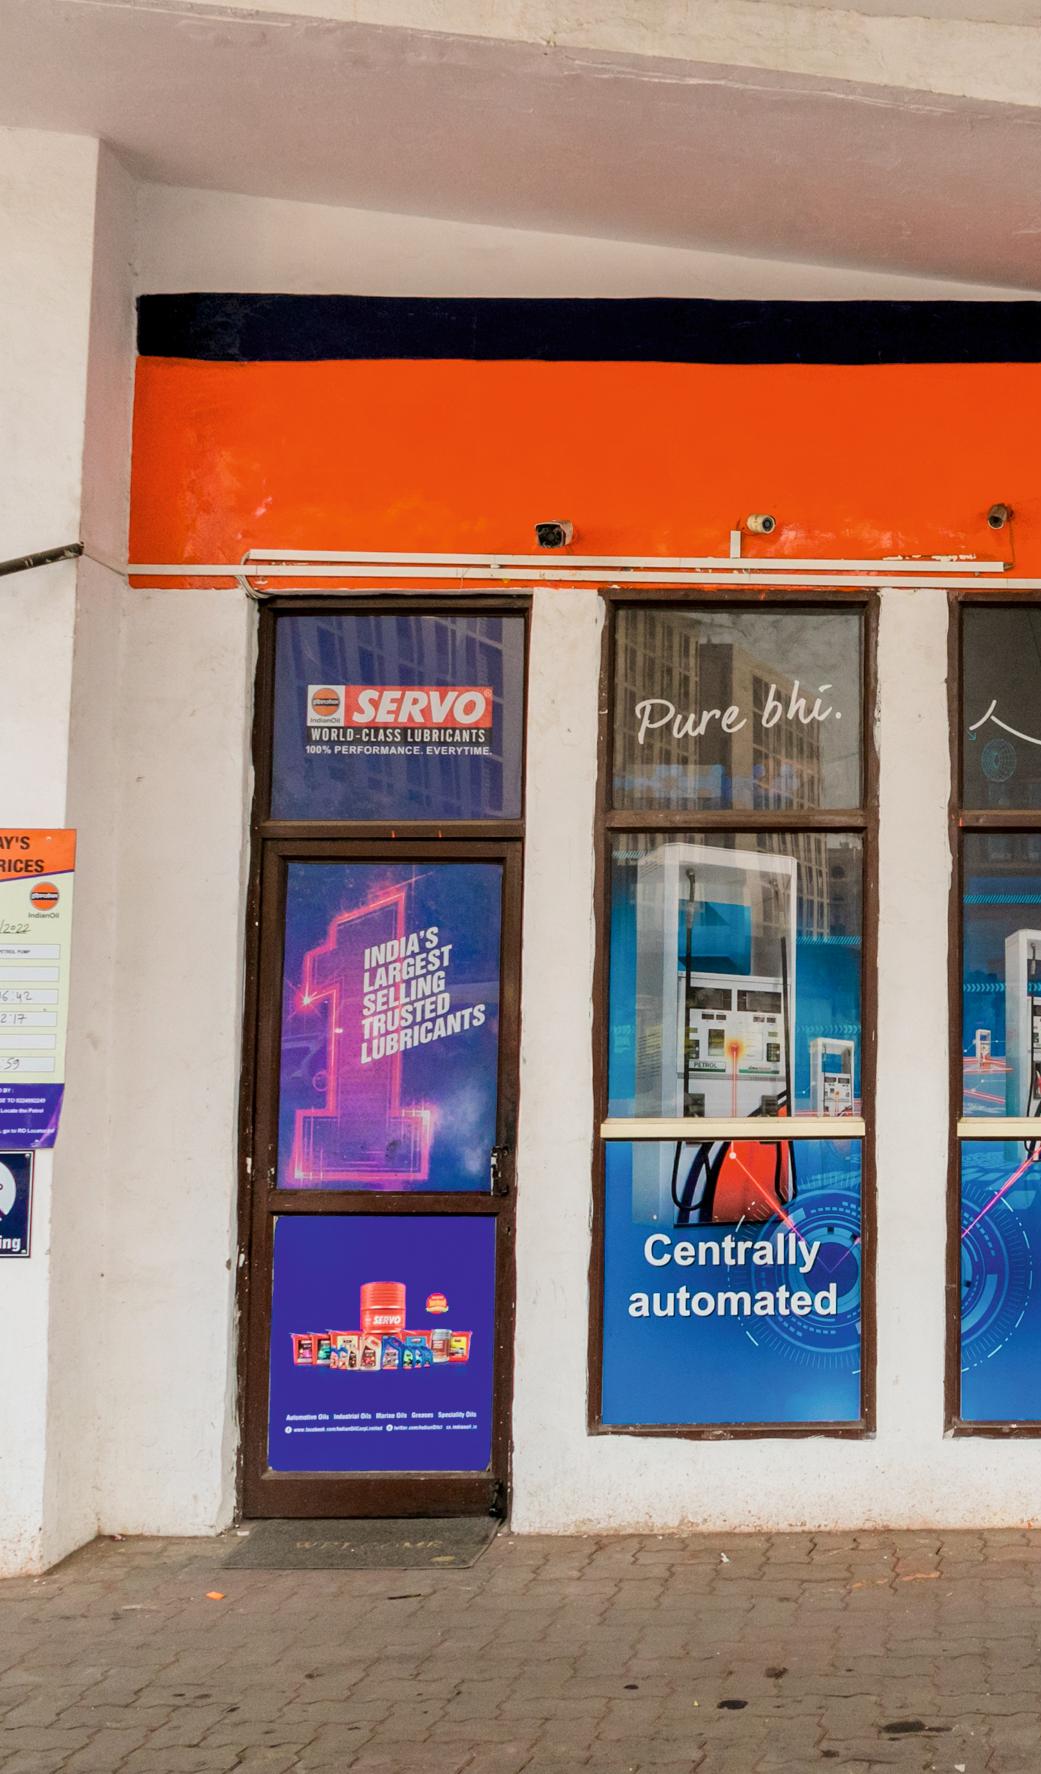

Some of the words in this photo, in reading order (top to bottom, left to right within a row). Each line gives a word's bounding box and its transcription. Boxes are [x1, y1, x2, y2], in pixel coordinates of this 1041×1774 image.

[352, 689, 486, 724] SERVO
[635, 698, 747, 744] Pure
[761, 680, 842, 728] bhi.
[305, 745, 331, 754] 100%
[334, 745, 423, 755] PERFORMANCE.
[426, 746, 493, 755] EVERYTIME.
[311, 727, 401, 742] WORLD-CLASS
[407, 728, 485, 743] LUBRICANTS
[364, 926, 438, 969] INDIA'S
[363, 944, 452, 993] LARGEST
[362, 971, 445, 1016] SELLING
[360, 1003, 486, 1065] LUBRICANTS
[361, 993, 450, 1039] TRUSTED
[644, 1232, 821, 1273] Centrally
[373, 1315, 401, 1325] SERVO
[628, 1283, 837, 1317] automated
[286, 1413, 317, 1421] Automotive
[465, 1410, 477, 1418] Oils
